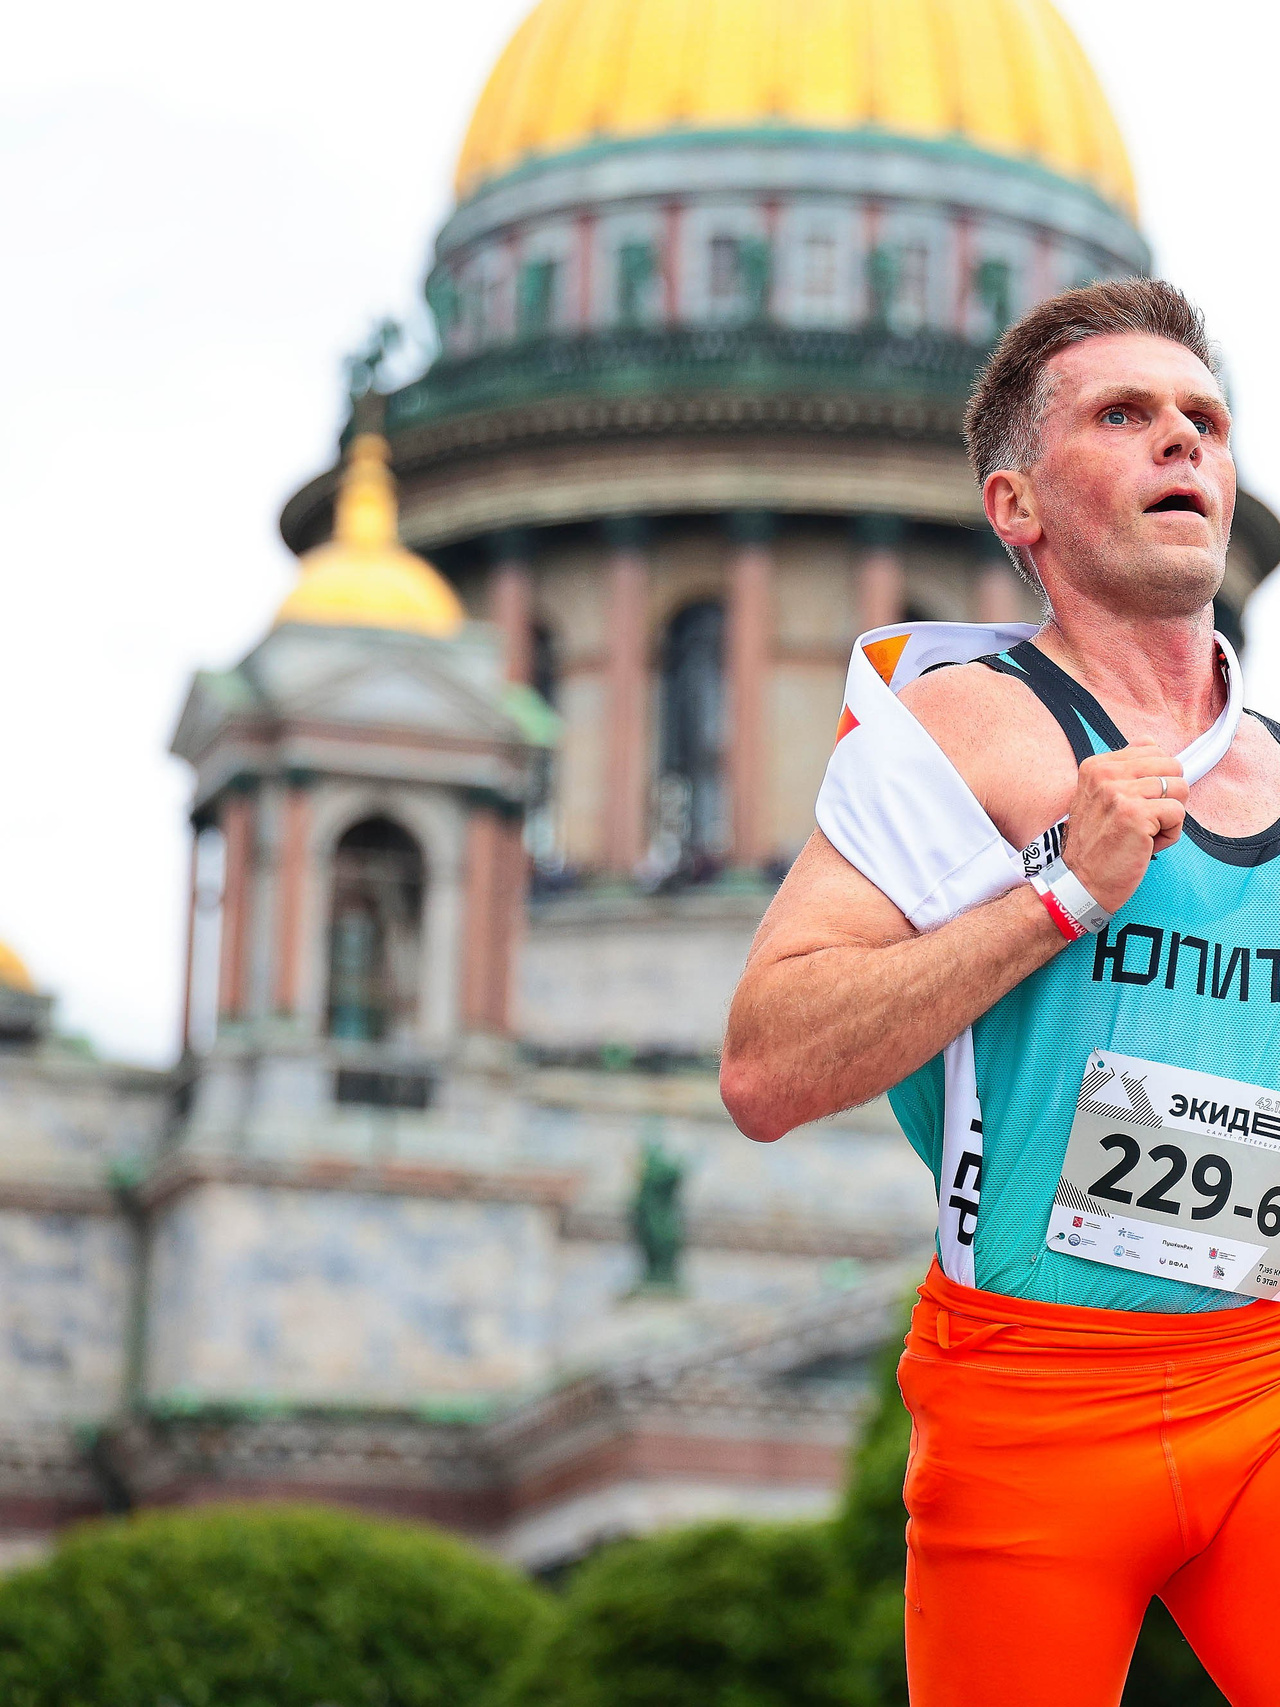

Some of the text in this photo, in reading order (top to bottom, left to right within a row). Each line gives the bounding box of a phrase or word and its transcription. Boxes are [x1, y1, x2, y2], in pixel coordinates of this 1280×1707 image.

[1168, 1259, 1189, 1270] ВФЛА
[1256, 1274, 1278, 1287] 6 этап
